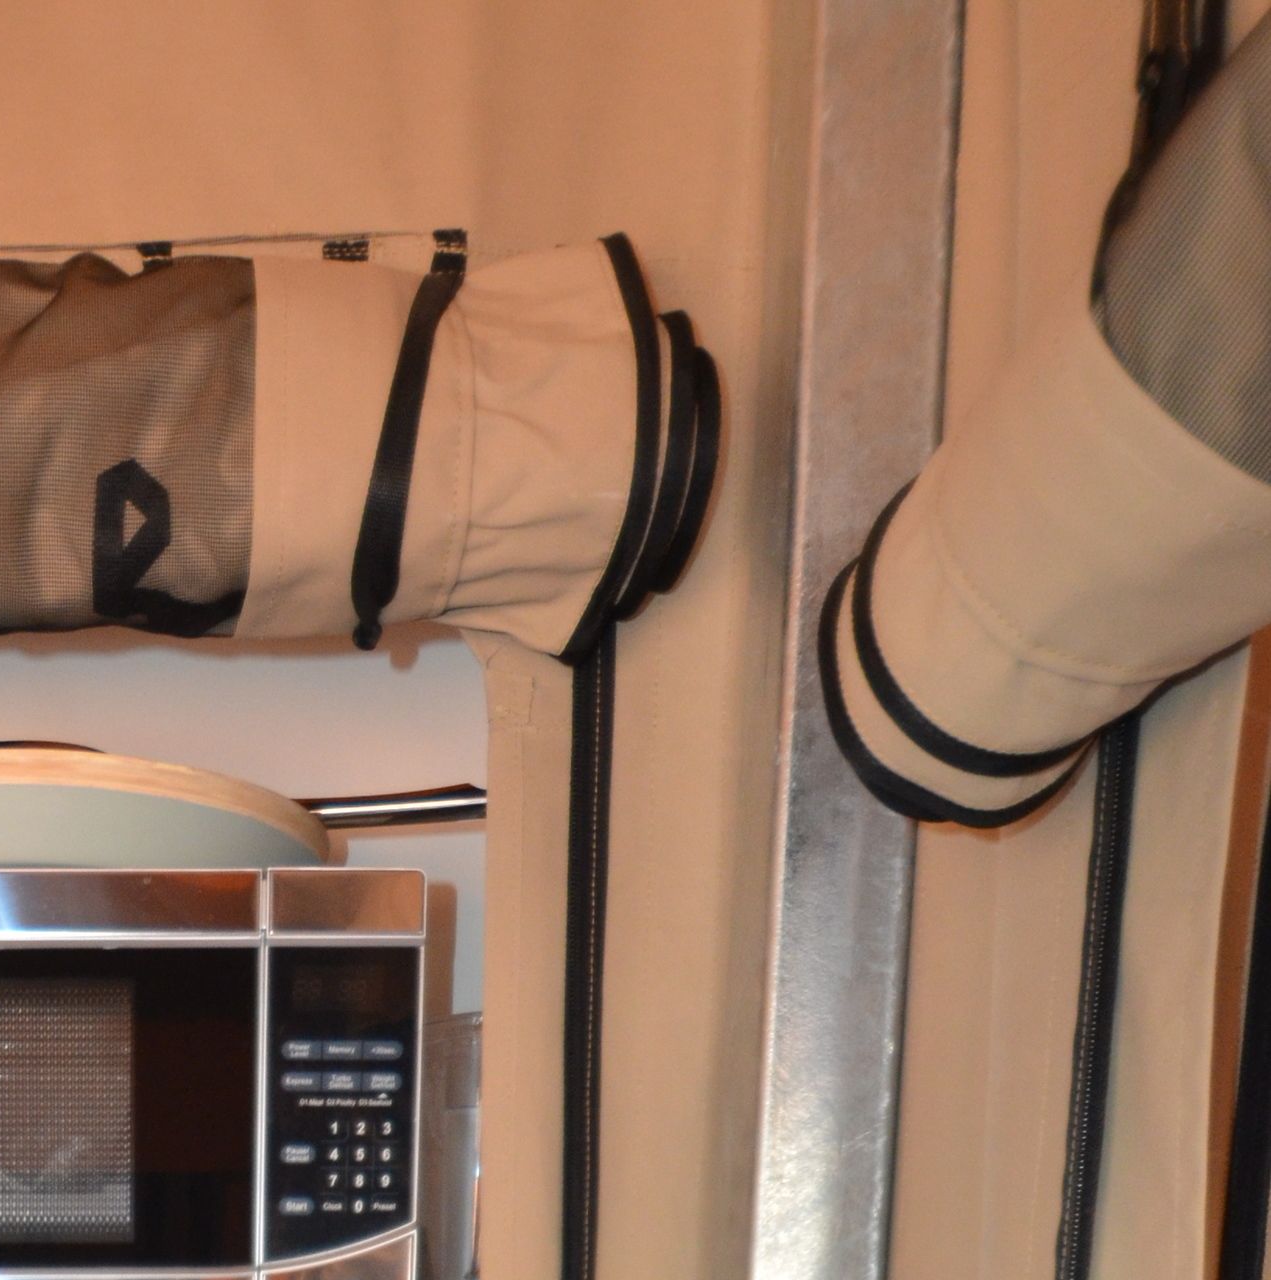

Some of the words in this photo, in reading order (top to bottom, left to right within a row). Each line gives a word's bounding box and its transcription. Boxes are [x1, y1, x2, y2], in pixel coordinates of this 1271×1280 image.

[330, 1121, 338, 1135] 1
[356, 1121, 366, 1135] 2
[382, 1121, 392, 1135] 3
[329, 1147, 339, 1161] 4
[355, 1147, 365, 1161] 5
[381, 1147, 391, 1162] 6
[329, 1174, 338, 1187] 7
[355, 1174, 364, 1188] 8
[381, 1174, 390, 1188] 9
[286, 1201, 308, 1211] Start
[354, 1199, 363, 1213] 0
